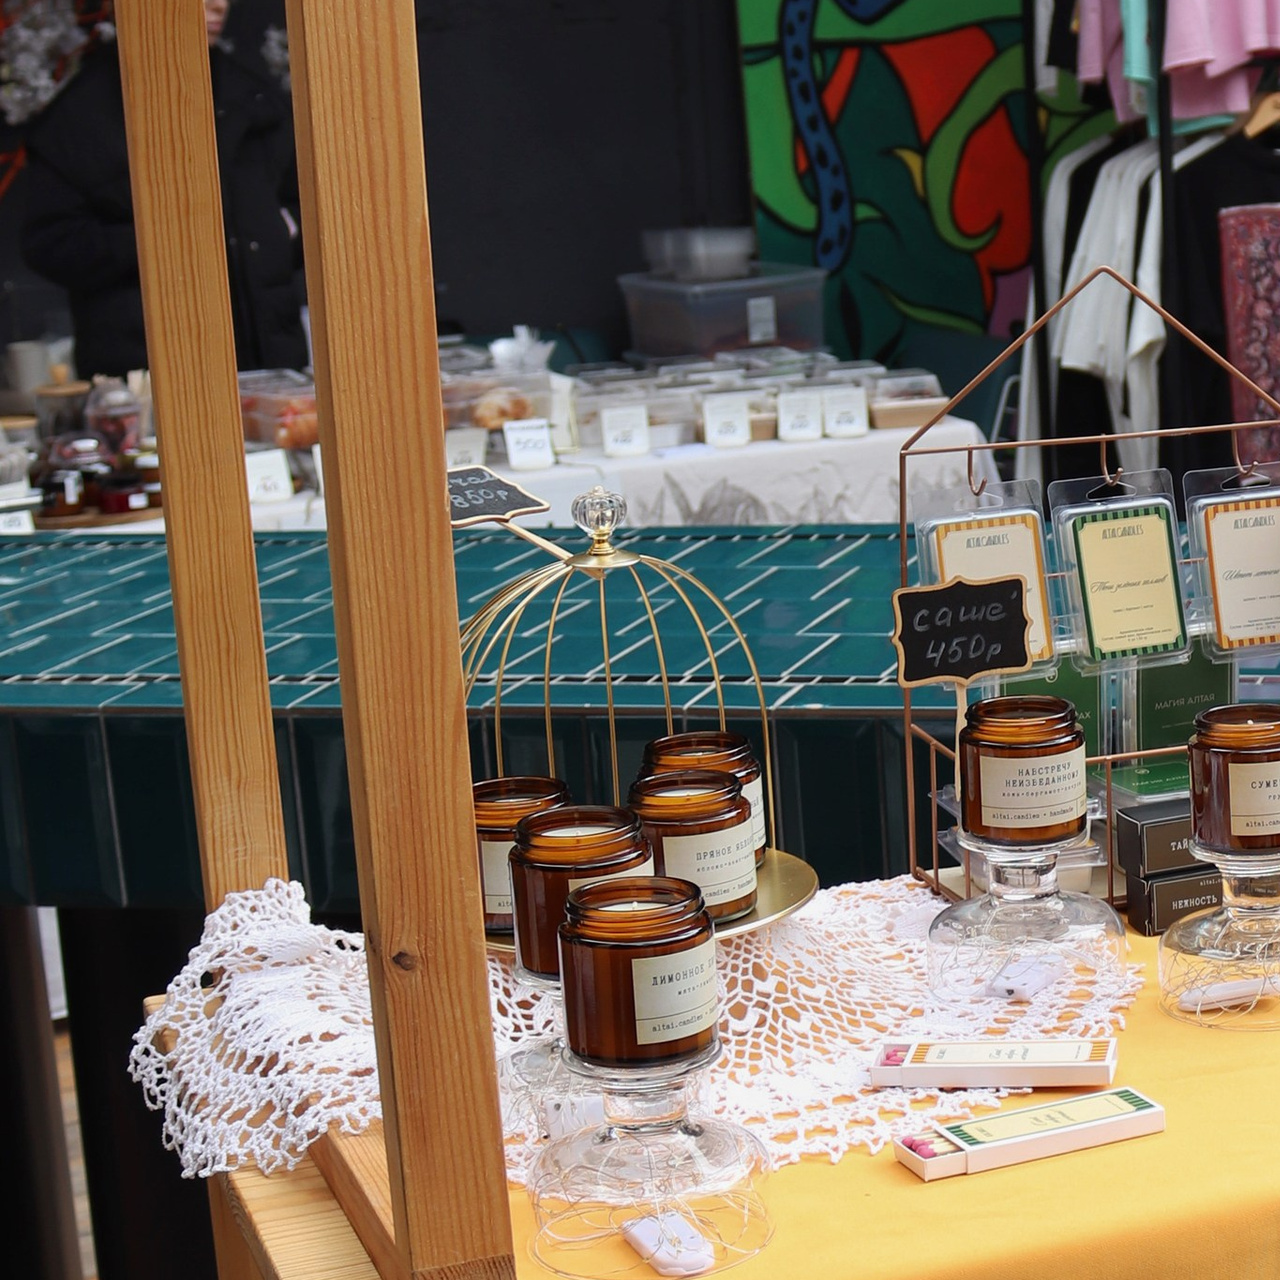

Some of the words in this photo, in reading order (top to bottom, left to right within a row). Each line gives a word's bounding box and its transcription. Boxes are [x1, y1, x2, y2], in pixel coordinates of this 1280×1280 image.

[925, 633, 1002, 668] 450р
[1154, 697, 1185, 710] МАГИЯ
[1187, 693, 1215, 706] АЛТАЯ
[1018, 761, 1072, 776] НАВСТРЕЧУ
[1005, 770, 1080, 788] НЕИЗВЕДАННОМУ
[992, 810, 1040, 820] altai.candles
[696, 845, 732, 861] ПРЯНОЕ
[1172, 894, 1218, 910] НЕЖНОСТЬ
[651, 963, 705, 987] ЛИМОННОЕ
[652, 1013, 704, 1032] altai.candles
